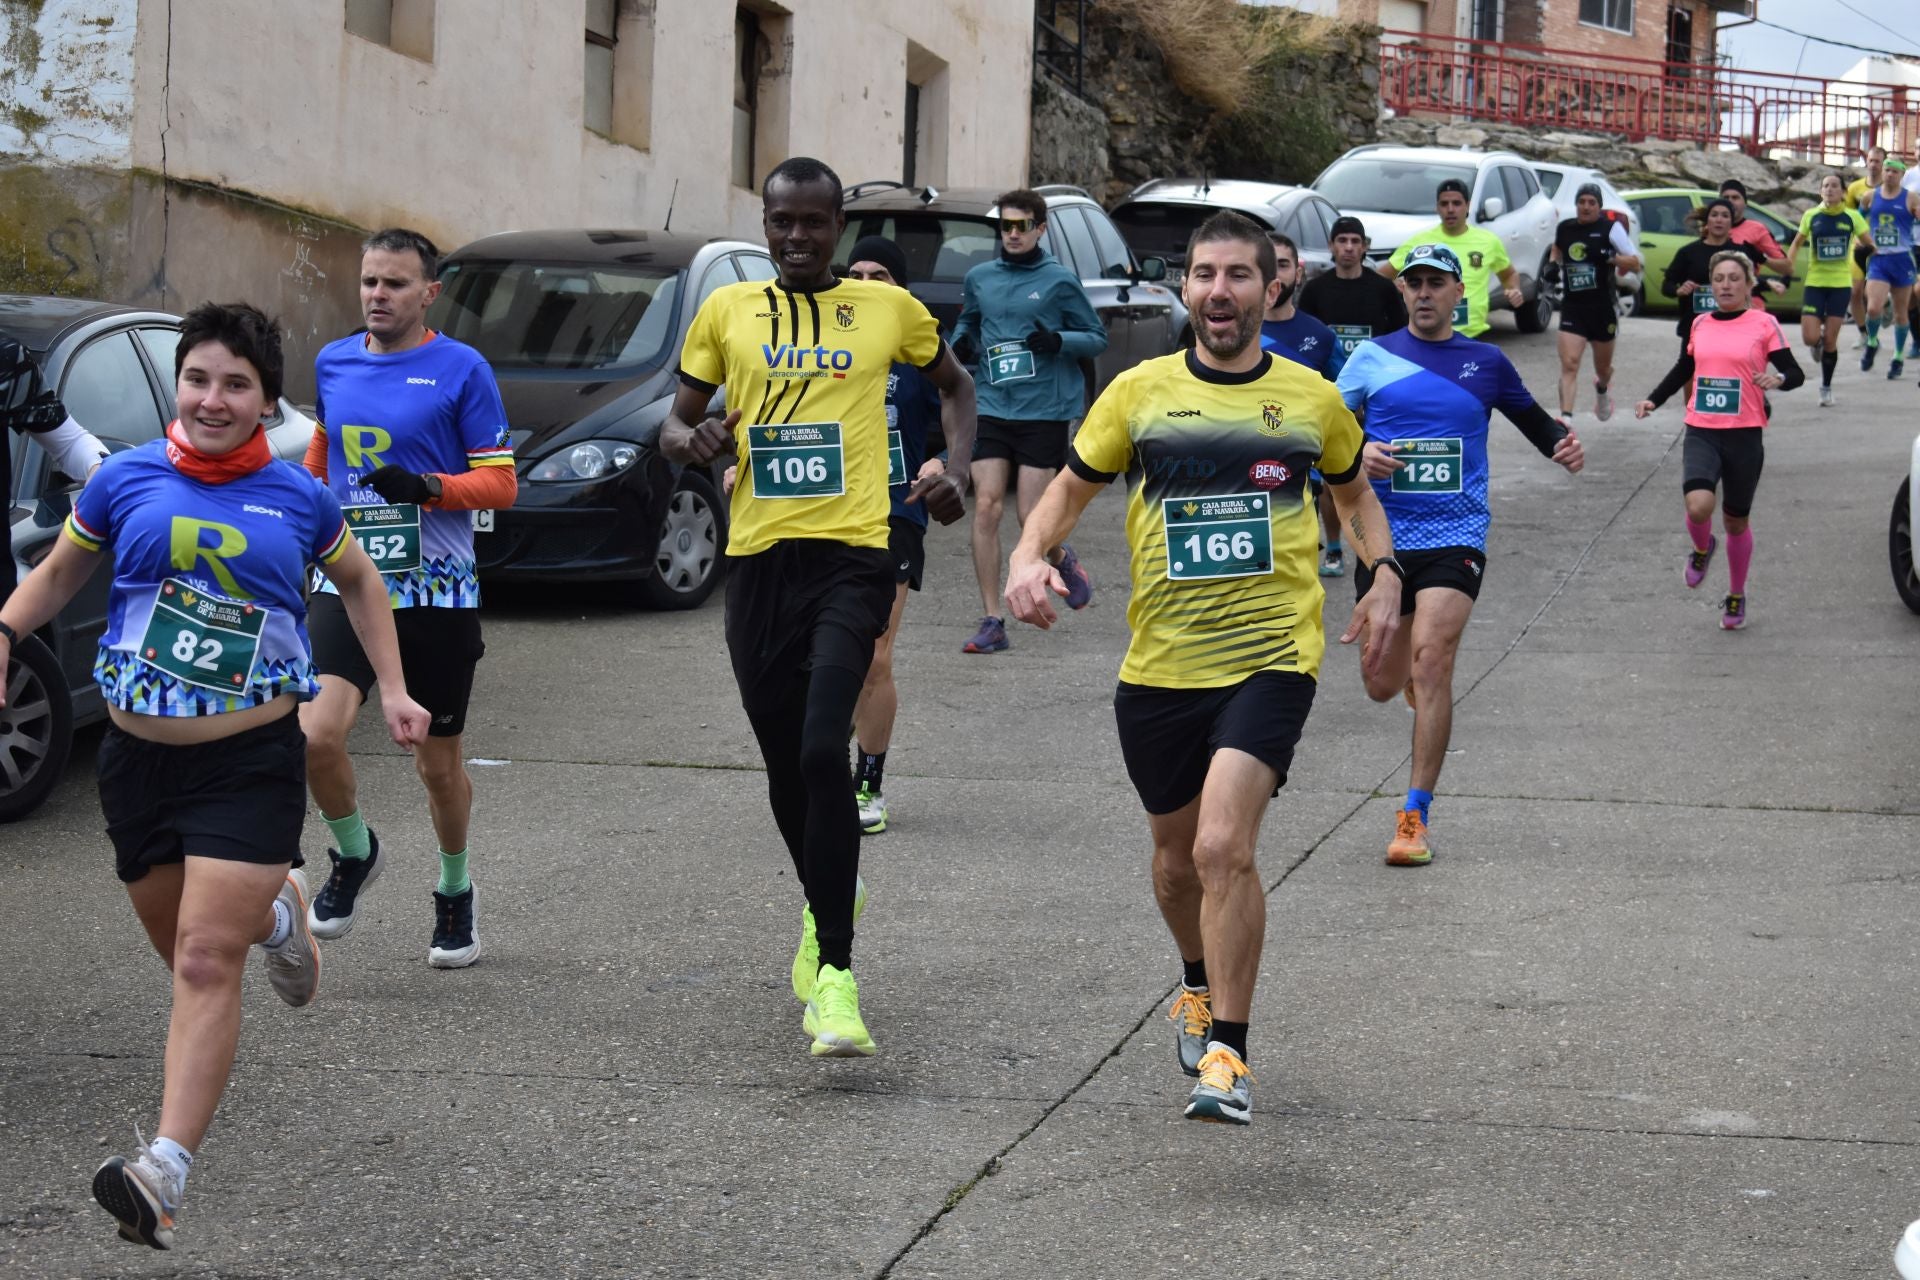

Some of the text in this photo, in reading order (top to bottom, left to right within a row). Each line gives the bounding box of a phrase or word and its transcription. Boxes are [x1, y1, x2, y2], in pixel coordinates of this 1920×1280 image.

[1822, 246, 1843, 256] 189
[1572, 276, 1590, 287] 251
[761, 343, 853, 371] Virto
[999, 358, 1020, 374] 57
[768, 370, 829, 379] ultracongelados
[1705, 393, 1728, 408] 90
[341, 424, 393, 470] R
[766, 456, 827, 484] 106
[1255, 464, 1286, 481] BENIS
[1403, 462, 1451, 483] 126
[1214, 506, 1250, 515] NAVARRA
[1220, 500, 1246, 508] RURAL
[1184, 531, 1255, 563] 166
[170, 515, 256, 601] R
[197, 605, 209, 616] DE
[208, 611, 242, 625] NAVARRA
[199, 599, 241, 617] CAJA RURAL
[172, 629, 224, 672] 82
